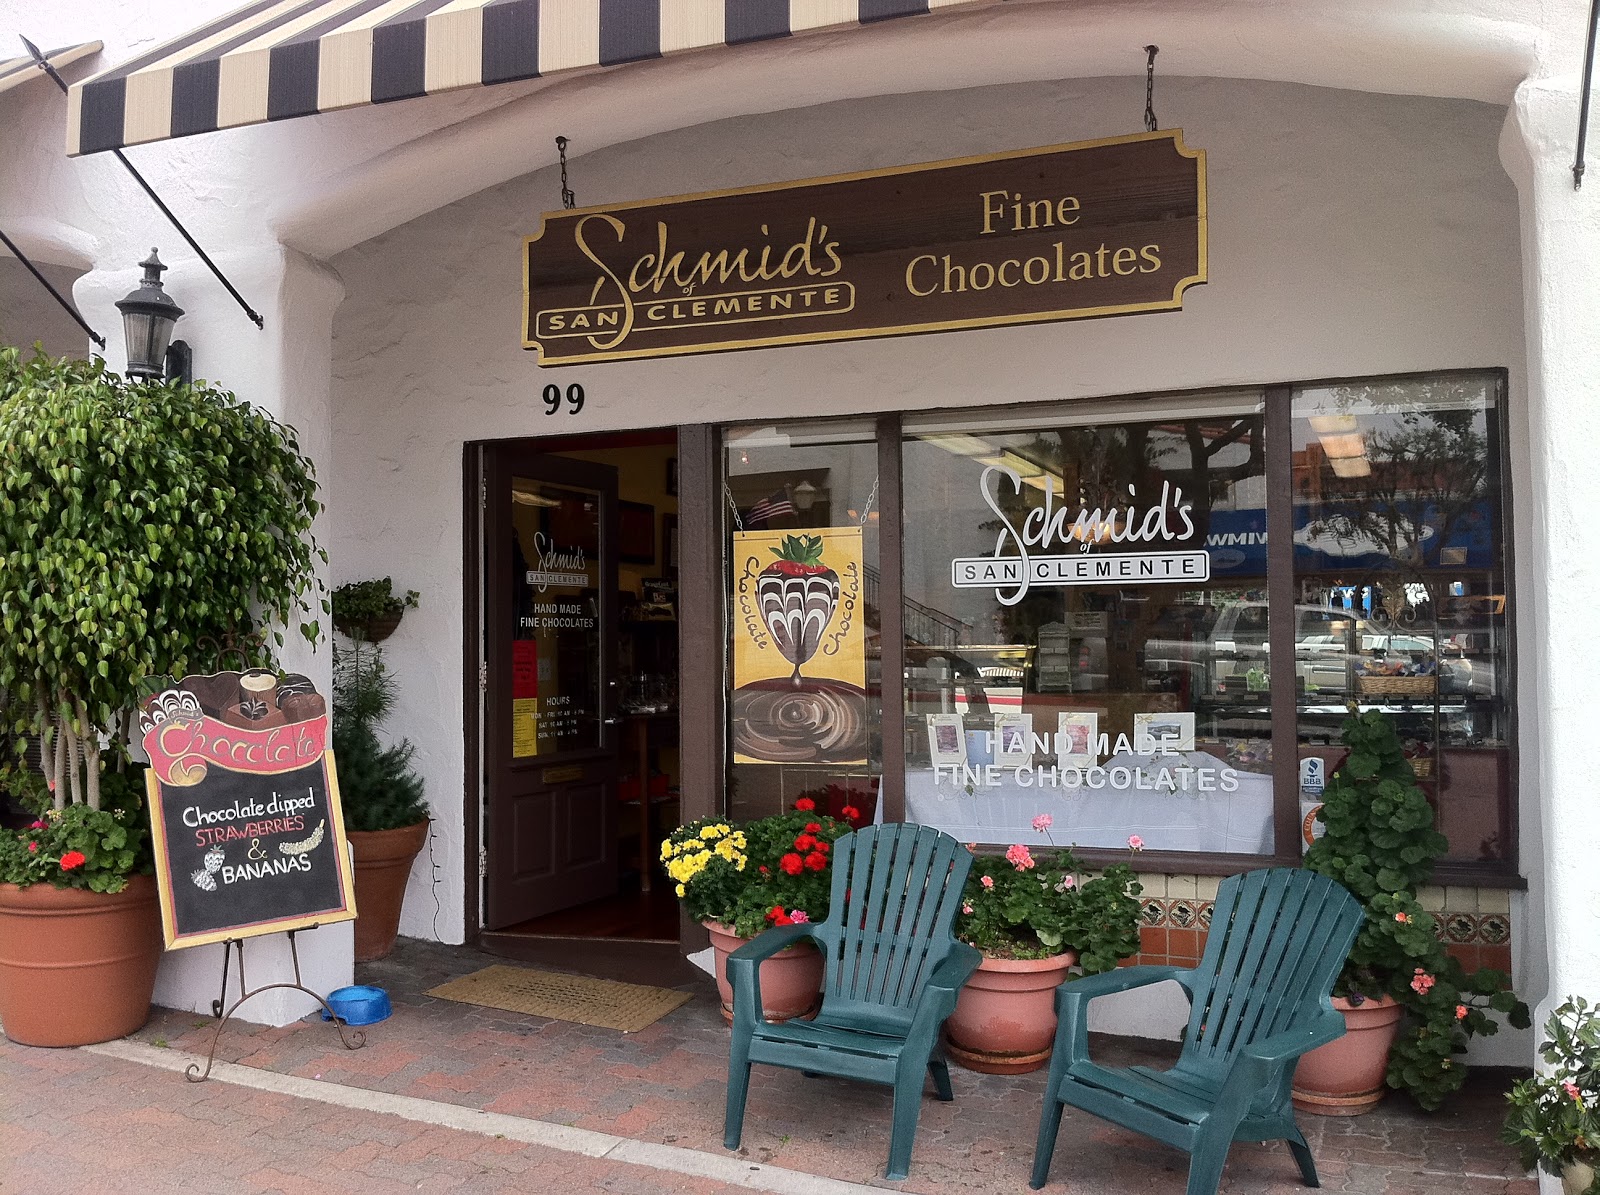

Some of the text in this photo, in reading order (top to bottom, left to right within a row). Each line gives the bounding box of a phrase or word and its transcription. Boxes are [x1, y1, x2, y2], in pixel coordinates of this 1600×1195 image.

[979, 190, 1082, 236] Fine
[574, 214, 843, 350] Schmid's
[905, 242, 1163, 298] Chocolates
[548, 287, 842, 331] SAN CLEMENTE
[541, 383, 587, 417] 99
[980, 465, 1196, 606] Schmid's
[1080, 540, 1093, 555] of
[534, 531, 585, 593] Schmid's
[964, 558, 1196, 580] SAN CLEMENTE
[529, 574, 586, 585] SAN CLEMENTE
[534, 603, 582, 615] HAND MADE
[738, 556, 769, 650] Chocolate
[822, 561, 861, 656] Chocolate
[520, 617, 594, 629] FINE CHOCOLATES
[546, 696, 570, 707] HOURS
[985, 731, 1181, 757] HAND MADE
[933, 763, 1240, 793] FINE CHOCOLATES
[182, 787, 316, 828] Chocolate dipped
[195, 815, 305, 847] STRAWBERRIES
[247, 838, 268, 861] &
[221, 853, 313, 885] BANANAS
